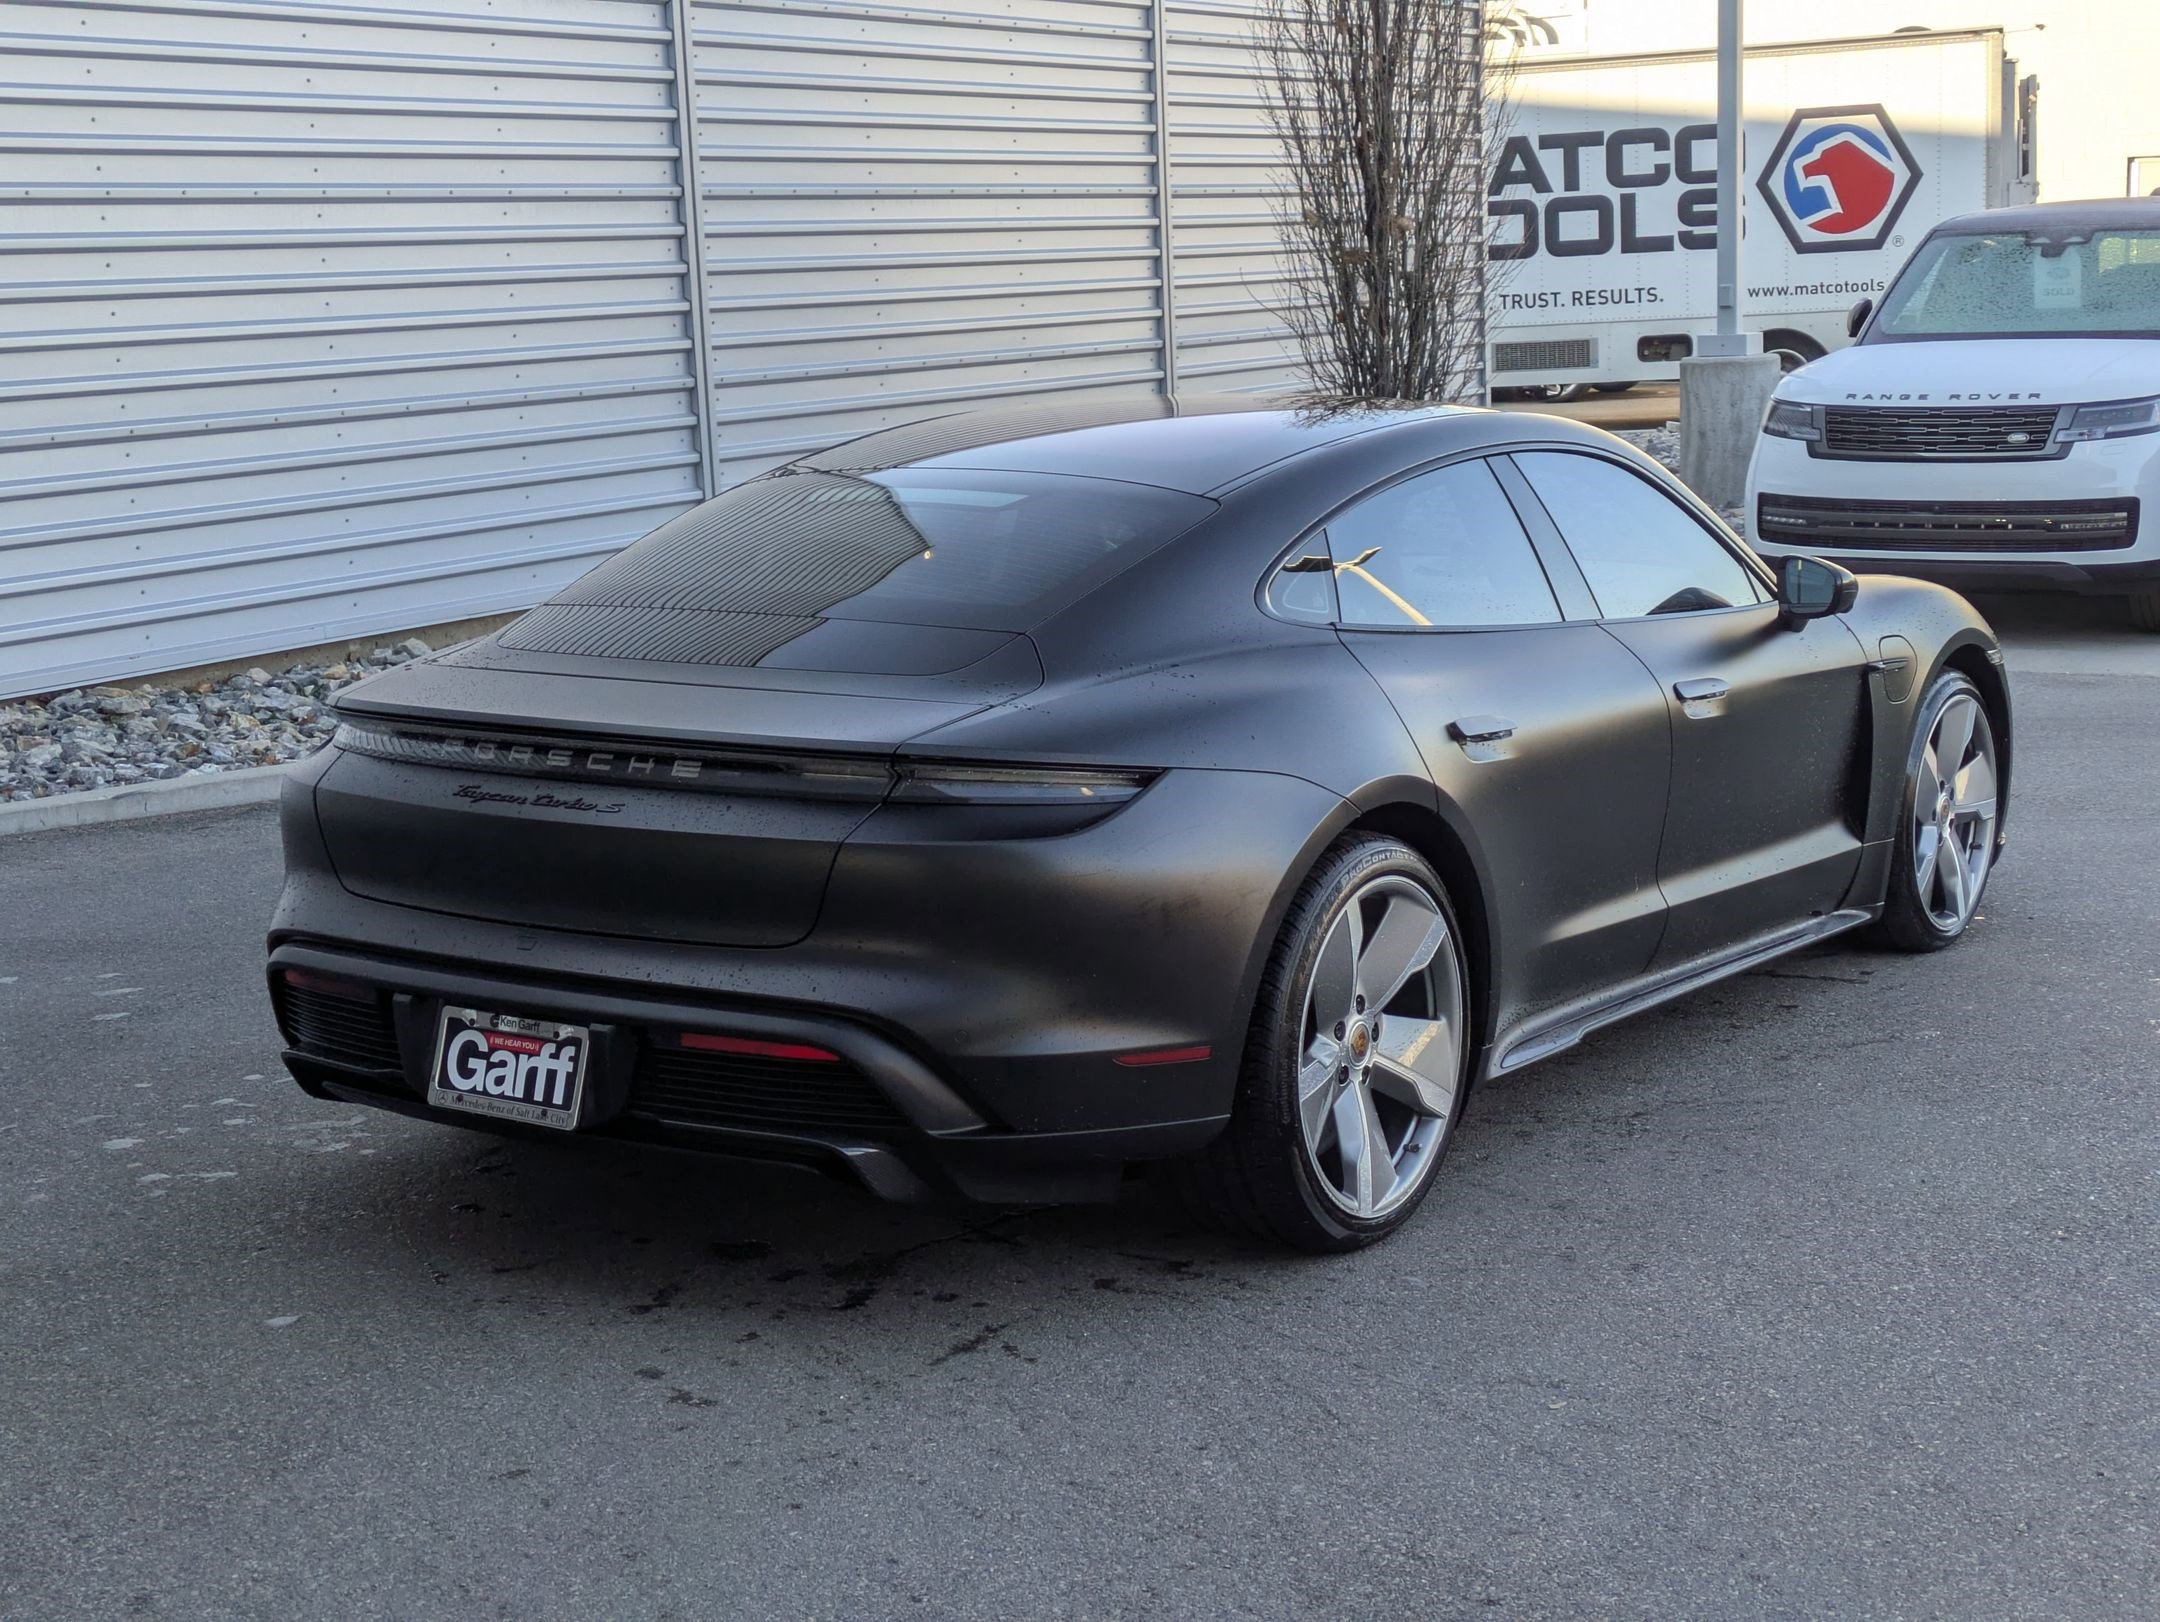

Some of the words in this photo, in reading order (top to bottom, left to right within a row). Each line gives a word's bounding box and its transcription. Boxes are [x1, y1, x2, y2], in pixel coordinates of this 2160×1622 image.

[1747, 278, 1885, 298] www.matcotools
[1500, 292, 1565, 310] TRUST.
[1571, 287, 1664, 306] RESULTS.
[1845, 393, 1930, 401] RANGE
[1948, 392, 2042, 401] ROVER
[444, 739, 702, 778] PORSCHE
[596, 803, 626, 813] S
[500, 1016, 517, 1028] Ken
[518, 1020, 541, 1031] Garff
[494, 1037, 504, 1045] WE
[505, 1039, 521, 1047] HEAR
[522, 1041, 535, 1050] YOU
[447, 1029, 576, 1105] Garff
[506, 1107, 514, 1117] of
[516, 1108, 530, 1119] Salt
[550, 1112, 566, 1124] City
